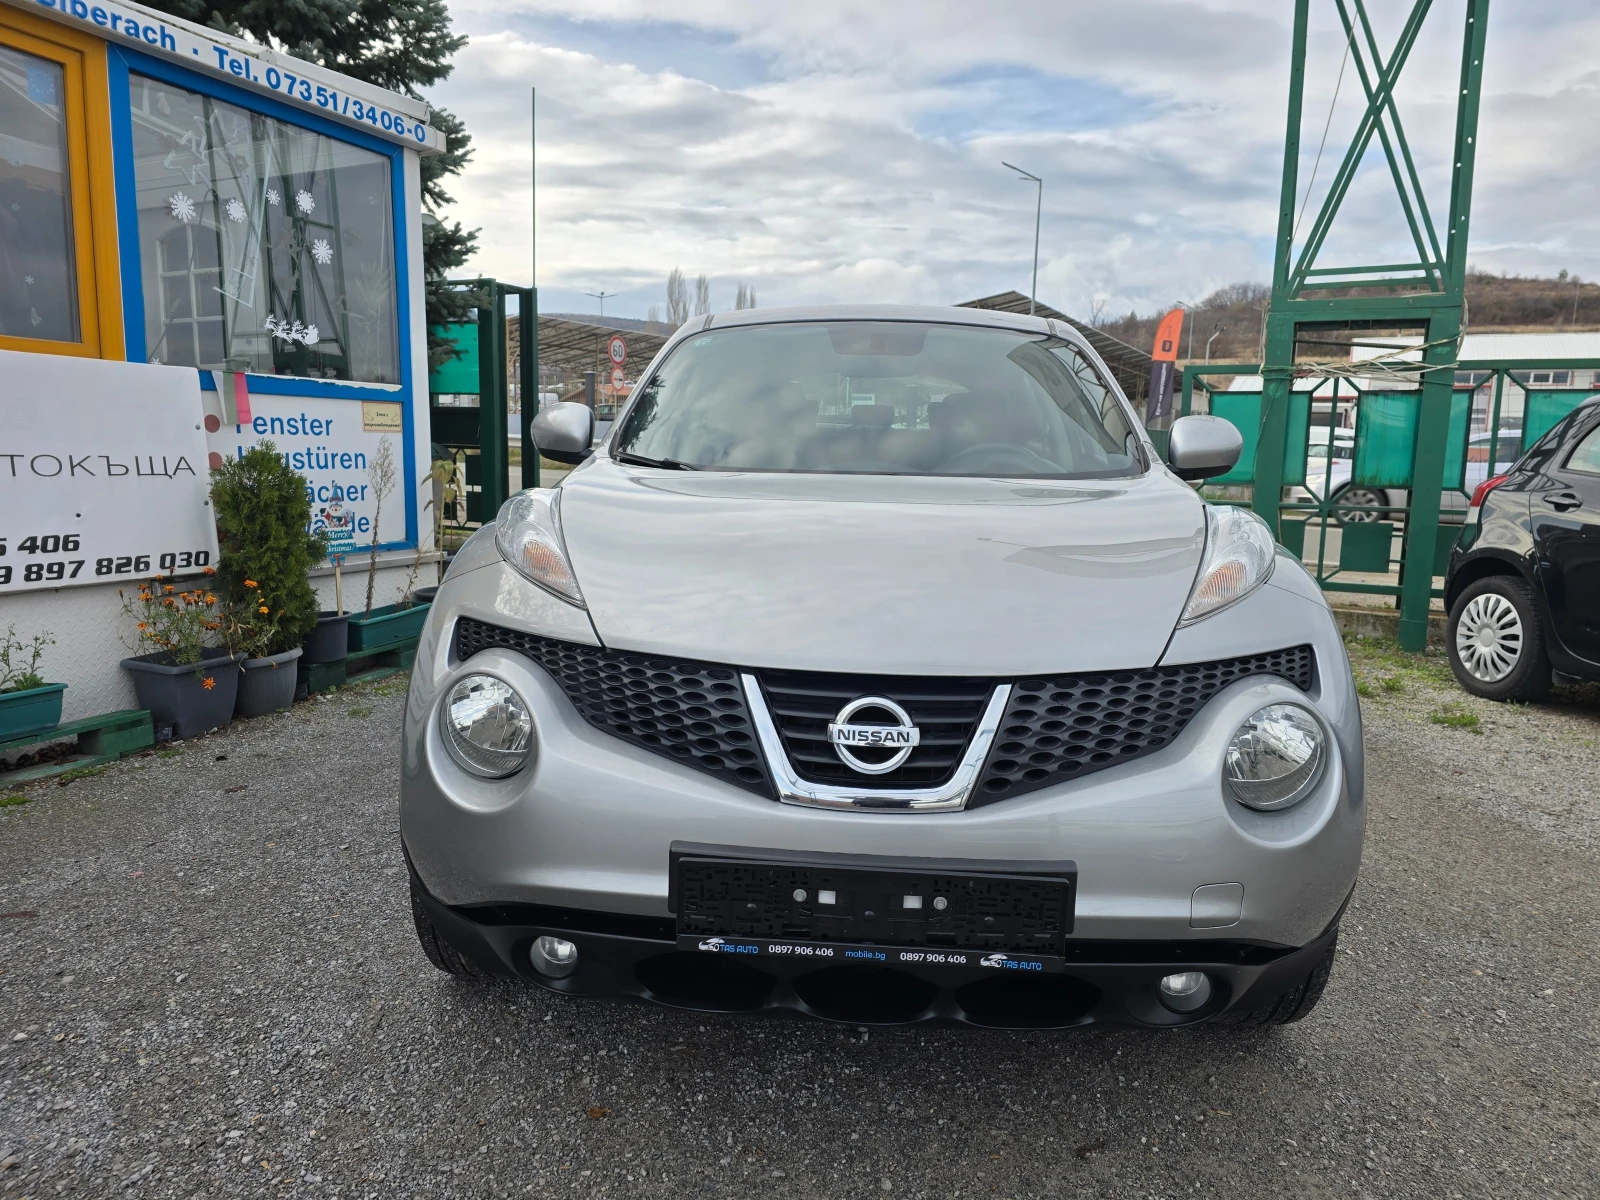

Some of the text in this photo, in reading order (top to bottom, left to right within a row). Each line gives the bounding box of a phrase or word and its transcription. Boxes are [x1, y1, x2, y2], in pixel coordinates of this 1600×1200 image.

[36, 0, 426, 143] iberach Tel. 07351/3406-0
[612, 344, 624, 358] 60
[17, 533, 81, 555] 406
[326, 544, 352, 552] hristmas
[23, 560, 86, 582] 897
[95, 555, 151, 576] 826
[159, 550, 210, 570] 030
[837, 728, 910, 744] NISSAN
[719, 944, 1042, 971] TAS AUTO 0897 906 406 mobile.bg 0897 906 406 TAS AUTO
